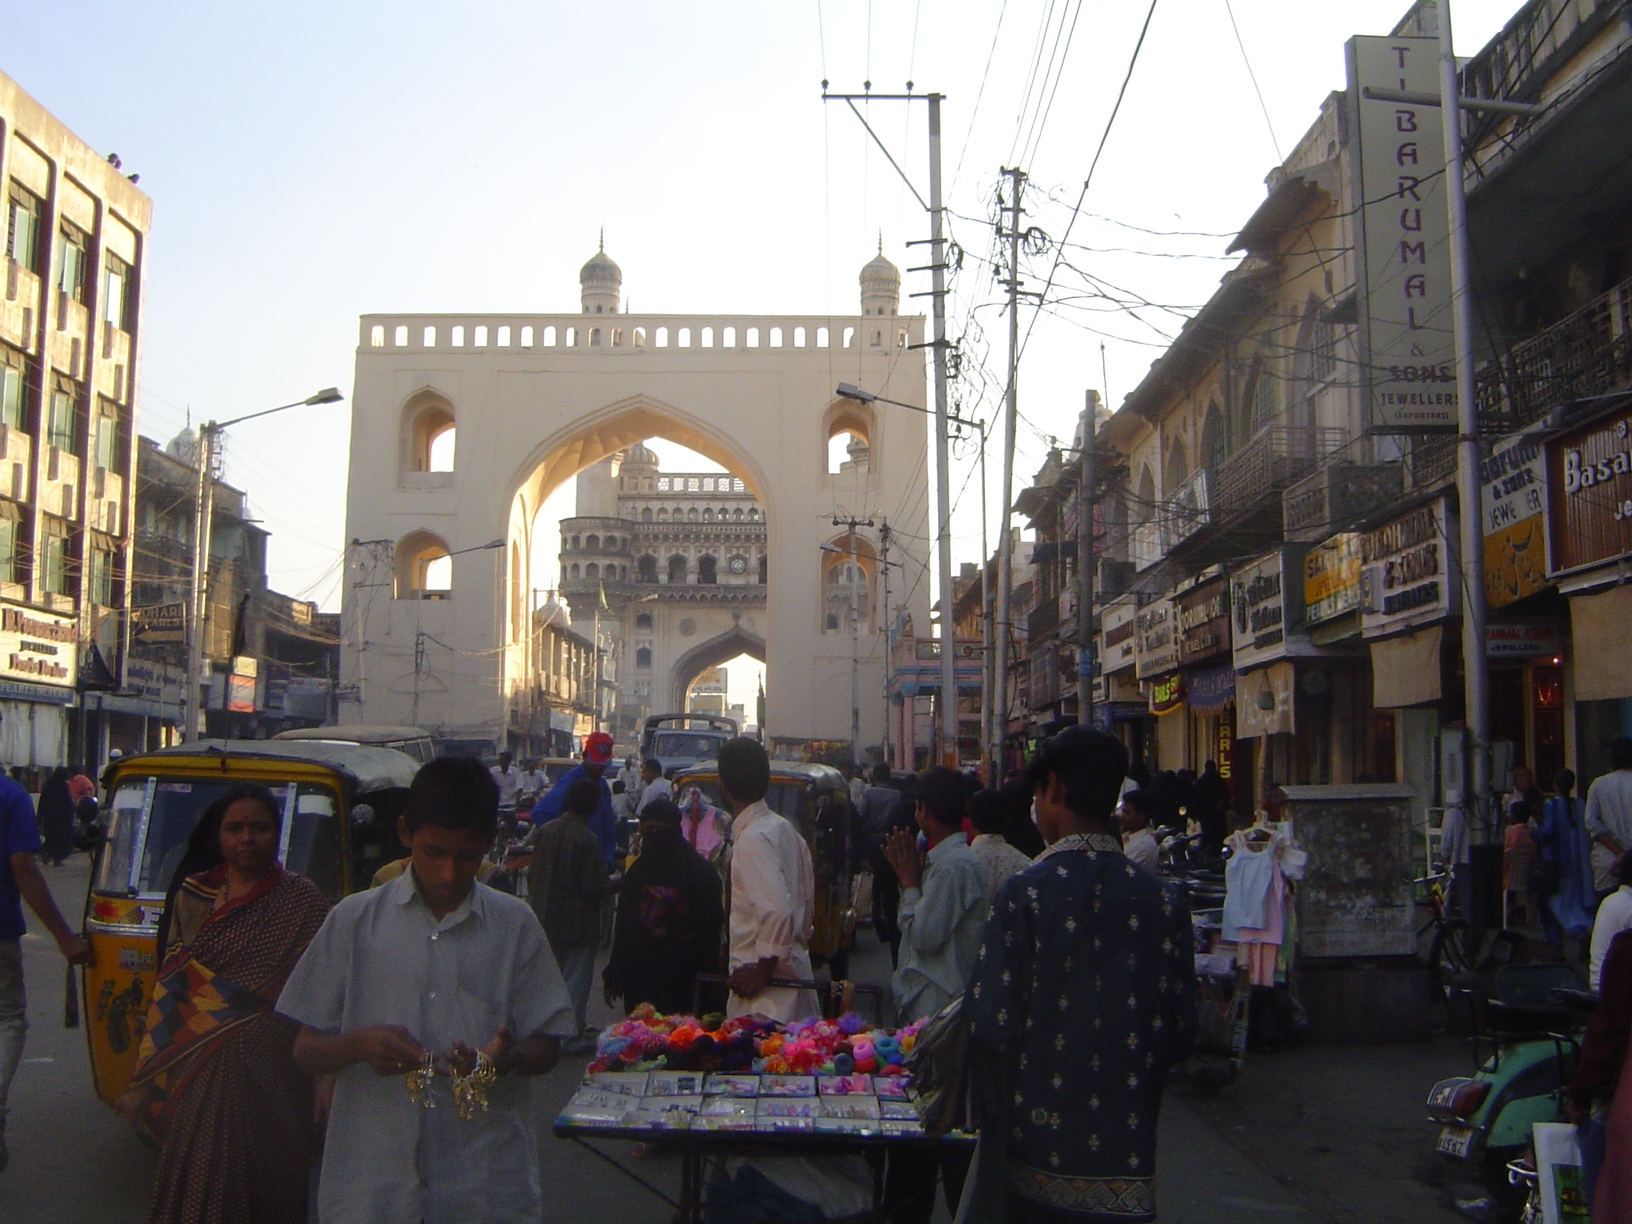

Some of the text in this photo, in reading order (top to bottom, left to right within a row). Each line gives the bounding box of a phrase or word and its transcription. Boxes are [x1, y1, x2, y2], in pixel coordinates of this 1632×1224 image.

[1389, 365, 1450, 383] SONS
[1564, 448, 1632, 497] Basa
[1219, 710, 1232, 780] EARLS
